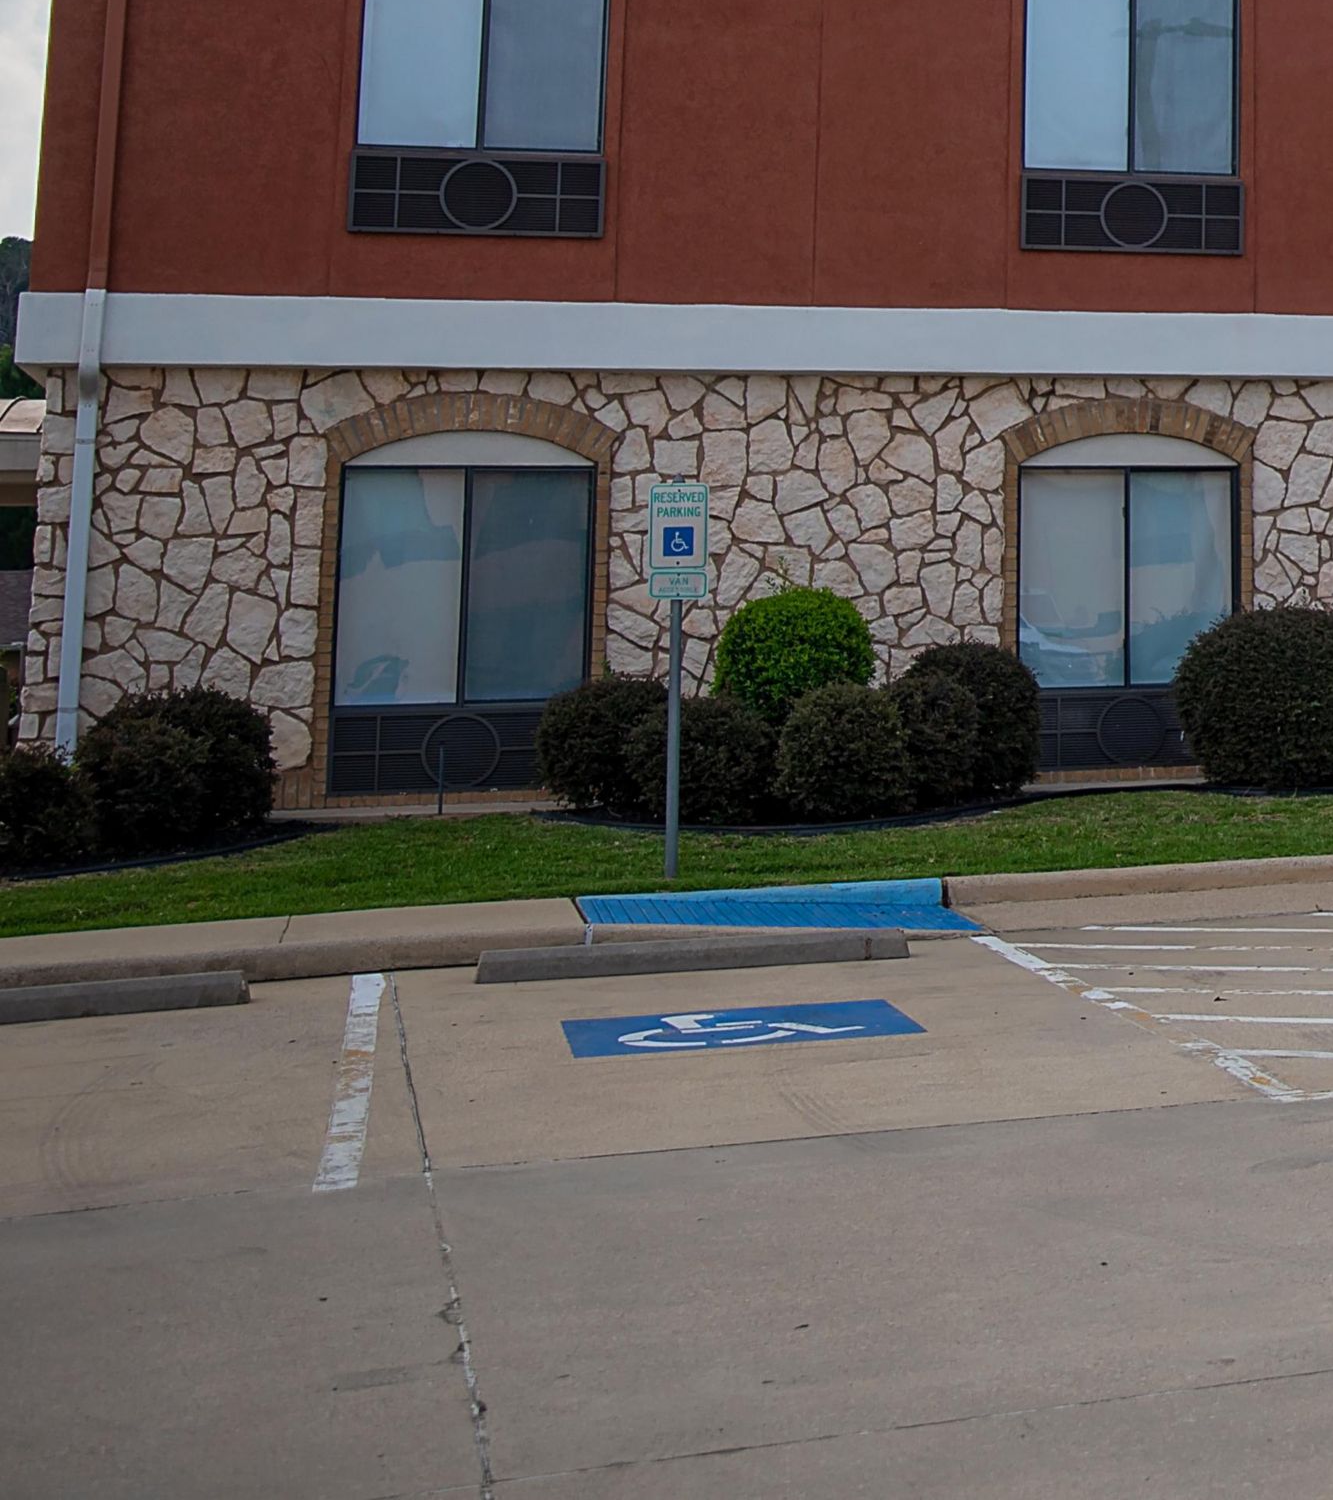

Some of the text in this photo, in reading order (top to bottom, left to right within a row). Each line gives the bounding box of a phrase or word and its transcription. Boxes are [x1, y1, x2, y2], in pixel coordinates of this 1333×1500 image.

[653, 492, 705, 503] RESERVED
[657, 507, 701, 517] PARKING
[669, 578, 689, 586] VAN
